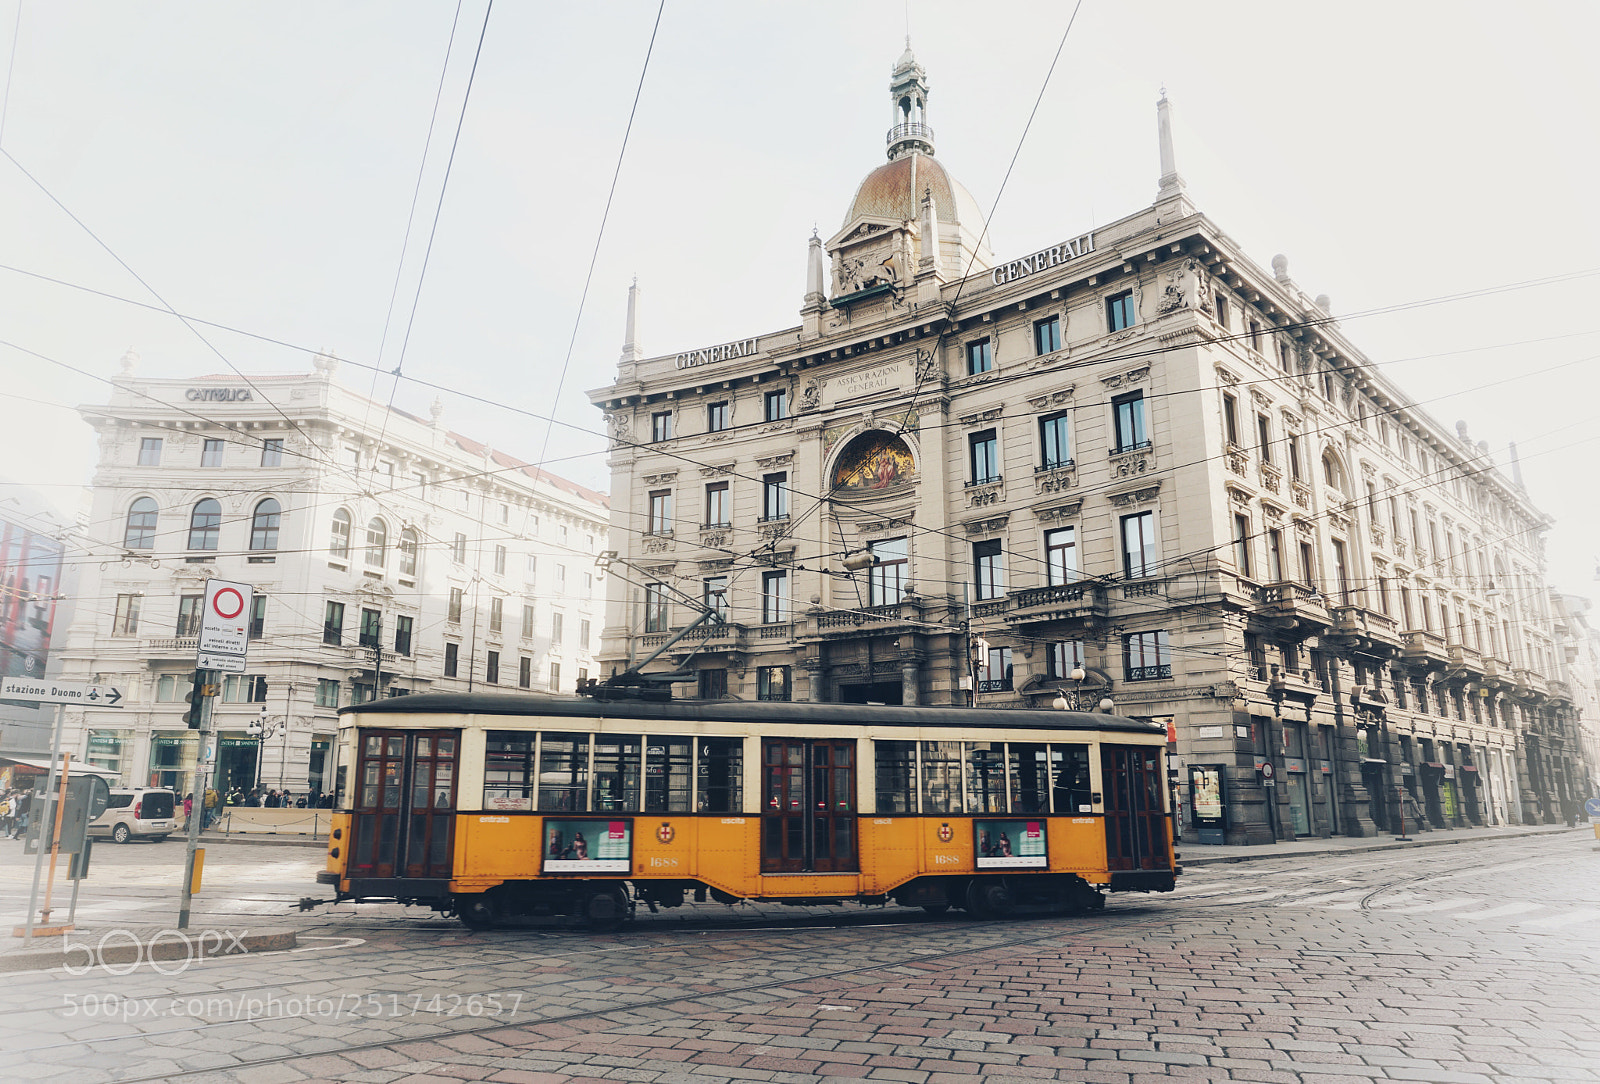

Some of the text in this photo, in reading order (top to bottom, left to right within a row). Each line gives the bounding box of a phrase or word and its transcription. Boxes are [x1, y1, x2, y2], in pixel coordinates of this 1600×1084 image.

[992, 232, 1096, 286] GENERALI
[674, 337, 759, 370] GENERALI
[847, 378, 888, 394] GENERALI
[185, 387, 255, 402] CATTOLICA
[6, 684, 82, 698] stazione Duomo
[650, 857, 679, 867] 1688
[935, 855, 960, 865] 1688
